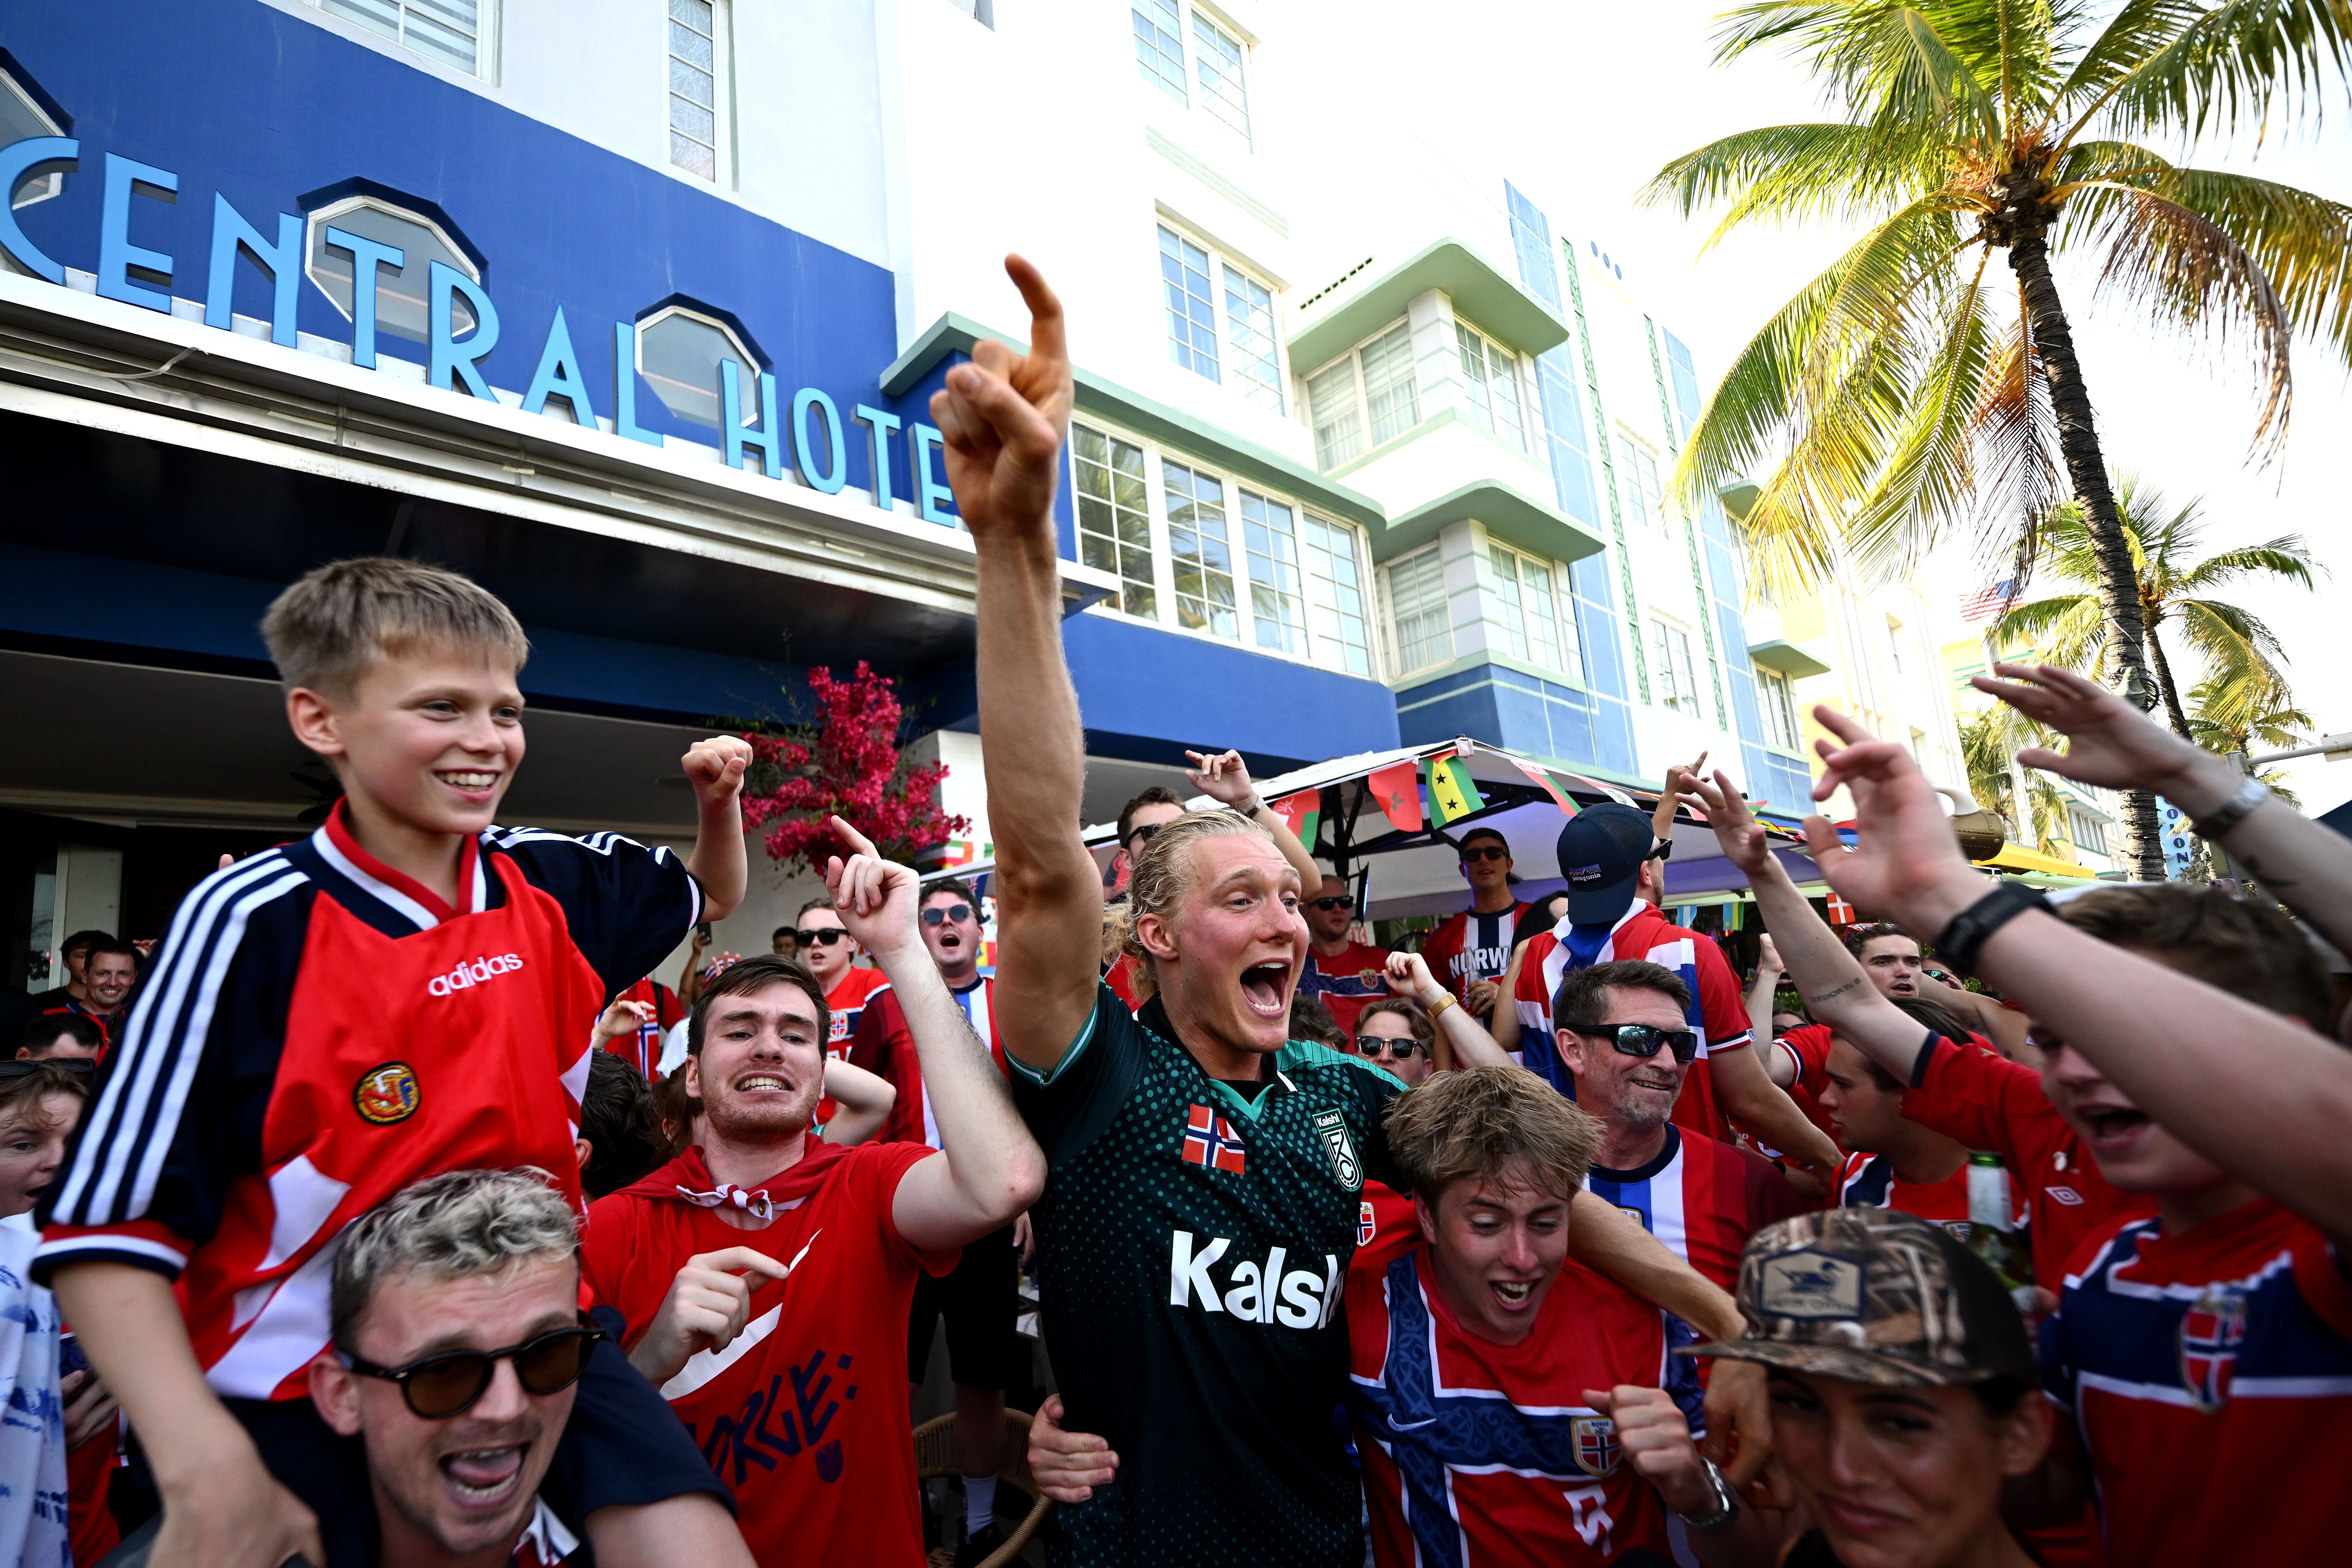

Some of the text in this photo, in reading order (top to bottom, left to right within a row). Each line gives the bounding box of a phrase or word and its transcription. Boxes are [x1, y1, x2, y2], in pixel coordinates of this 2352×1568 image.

[0, 136, 956, 529] CENTRAL HOTE
[1572, 873, 1601, 882] patagonia
[428, 953, 524, 996] adidas
[1449, 946, 1513, 979] NORW
[1316, 1113, 1341, 1128] Kalshi
[684, 1348, 858, 1486] ORGE:
